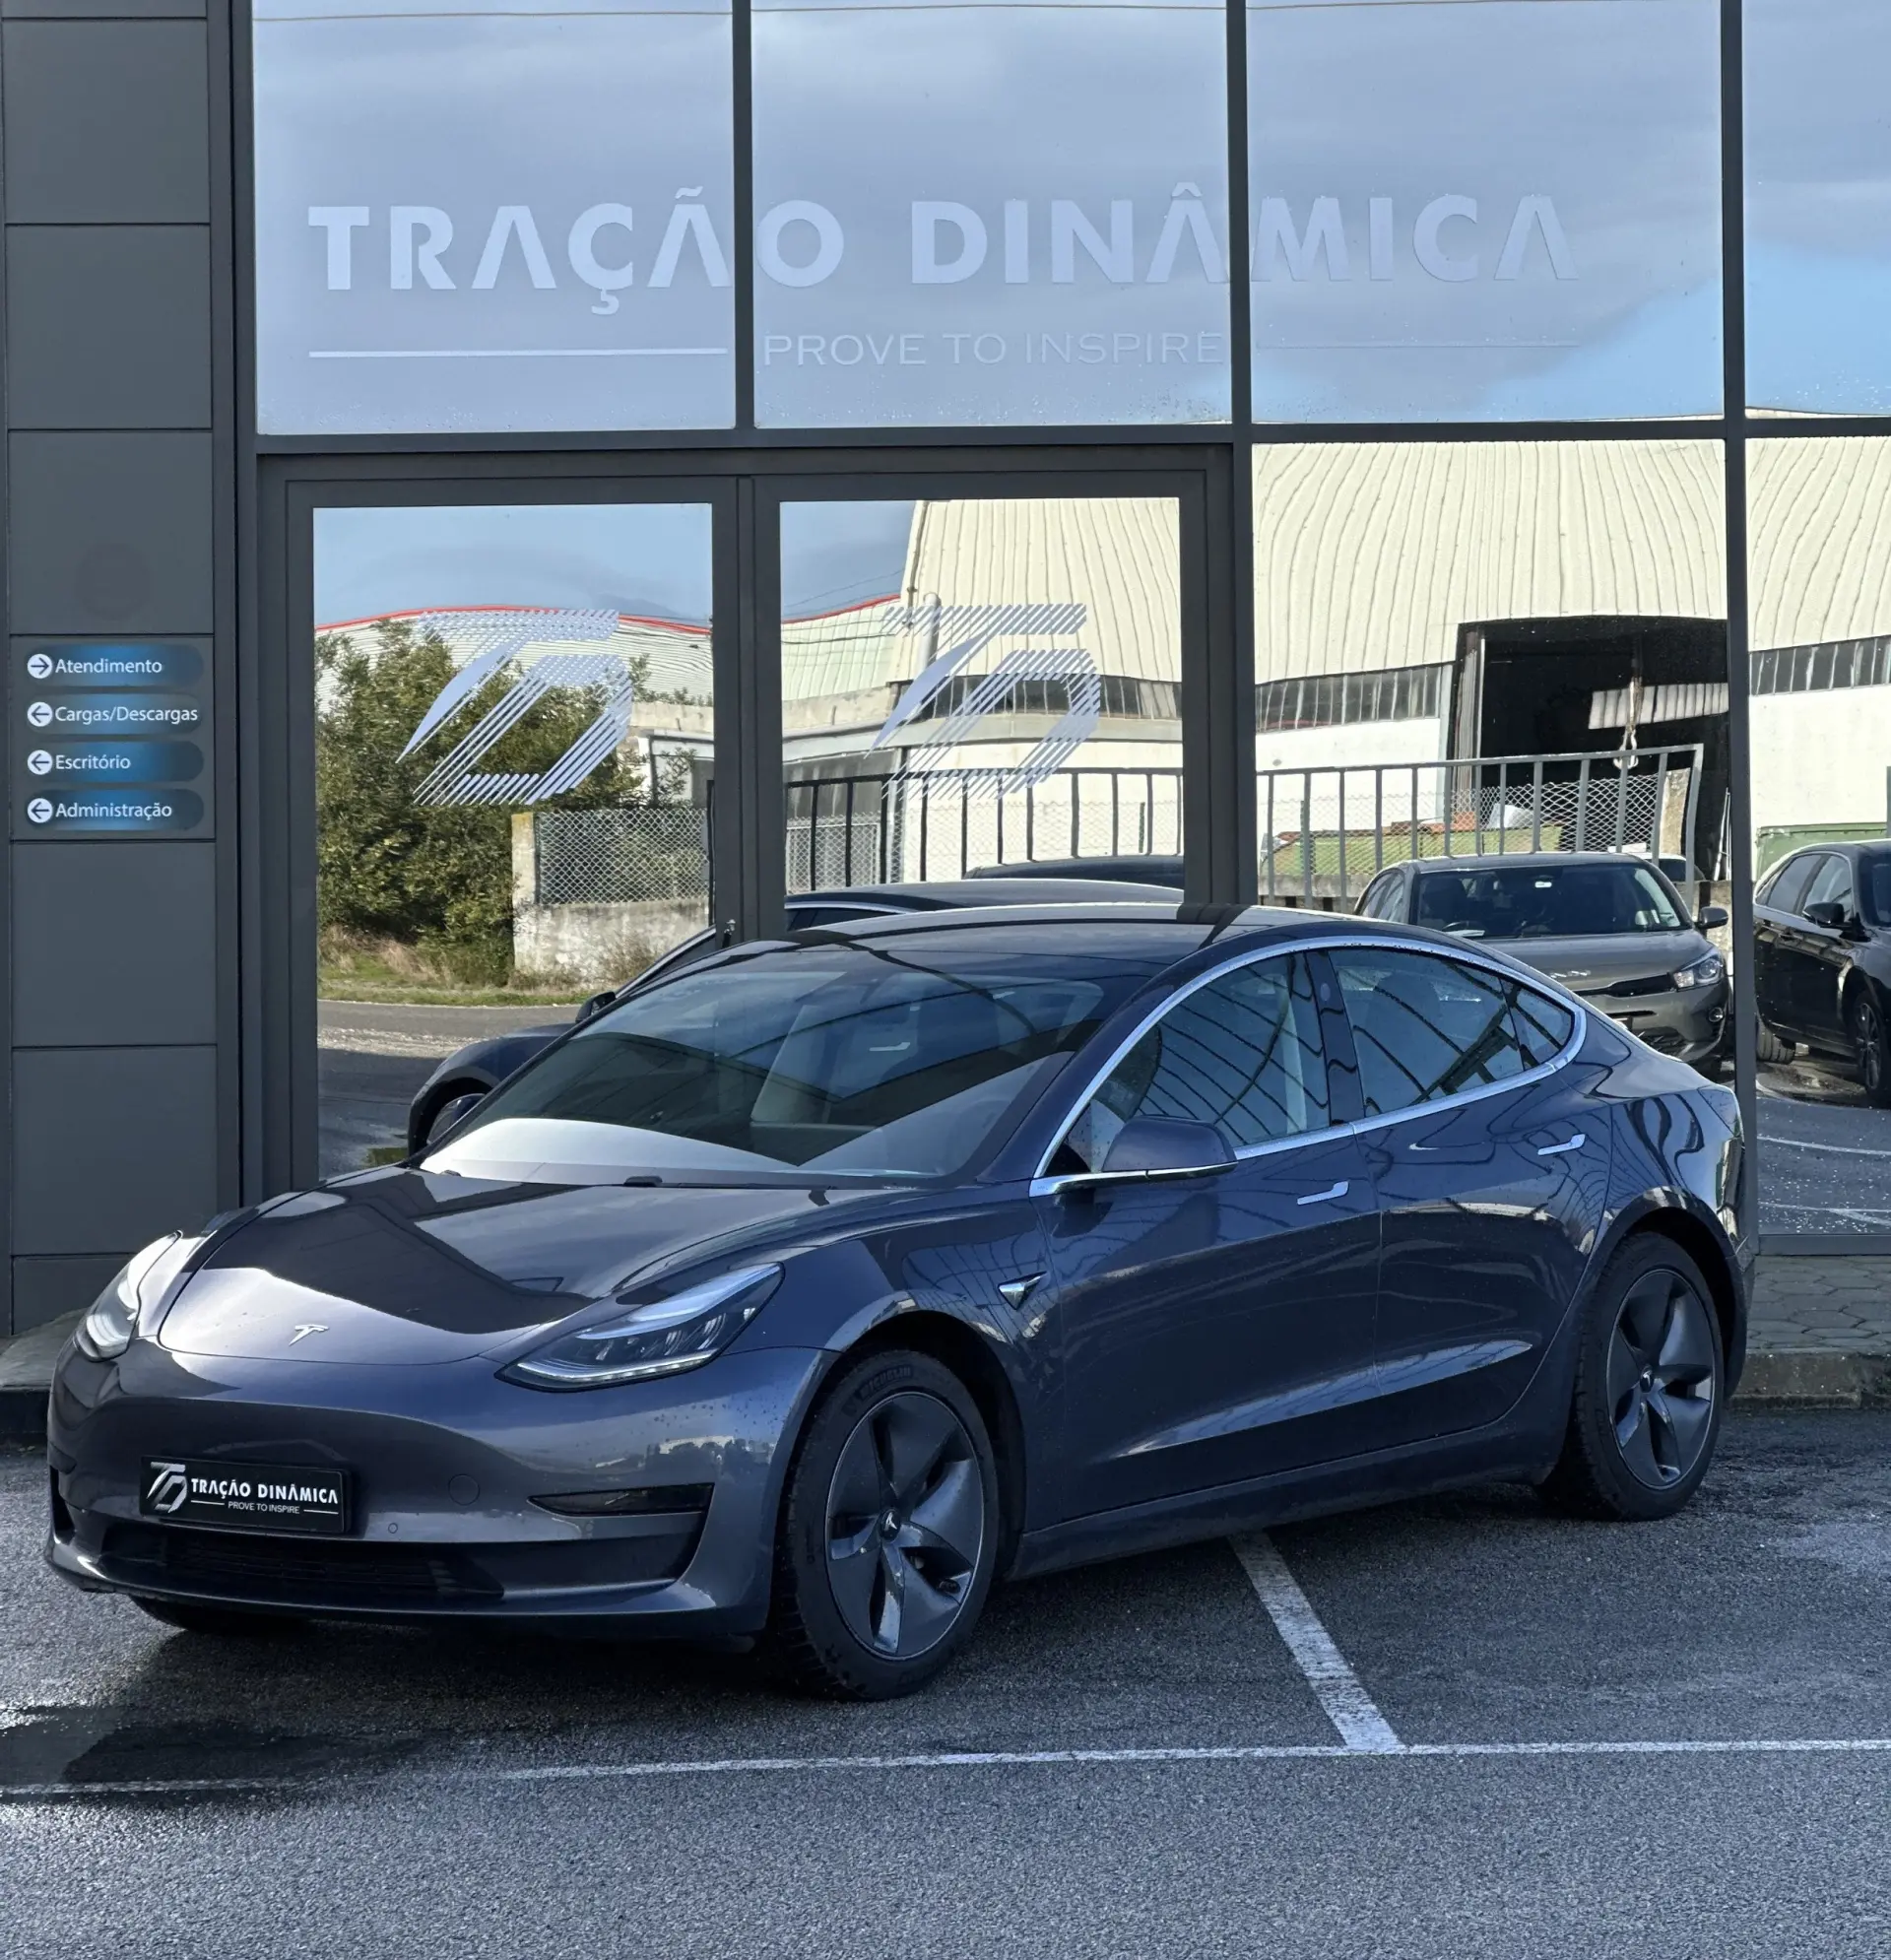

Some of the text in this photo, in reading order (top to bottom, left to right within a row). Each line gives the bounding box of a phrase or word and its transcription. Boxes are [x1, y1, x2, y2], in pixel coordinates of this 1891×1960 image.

[307, 182, 1579, 315] TRAÇÃO DINÂMICA
[763, 332, 1224, 366] PROVE TO INSPIRE
[55, 658, 163, 674] Atendimento
[55, 706, 198, 725] Cargas/Descargas
[55, 754, 131, 770] Escritório
[55, 802, 172, 820] Administração
[191, 1477, 339, 1505] TRAÇÃO DINÂMICA
[228, 1500, 300, 1515] PROVE TO INSPIRE
